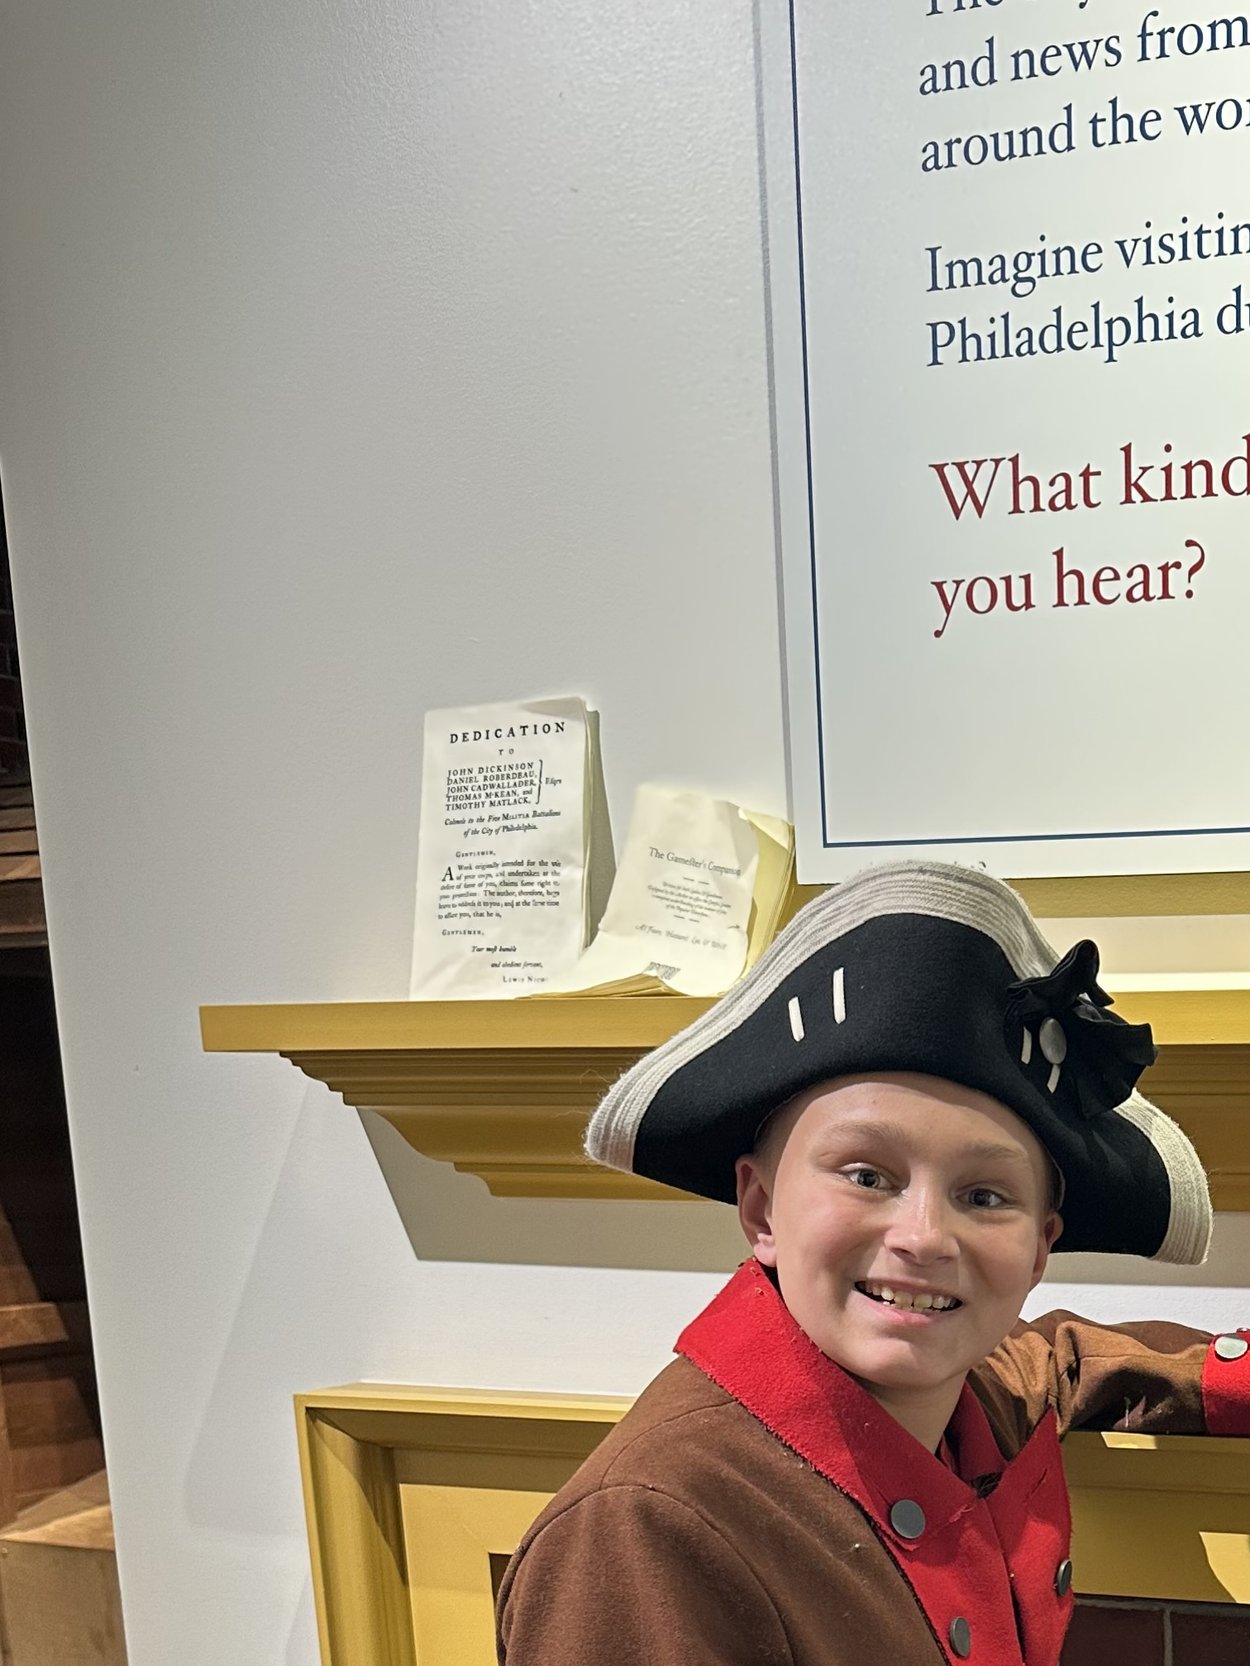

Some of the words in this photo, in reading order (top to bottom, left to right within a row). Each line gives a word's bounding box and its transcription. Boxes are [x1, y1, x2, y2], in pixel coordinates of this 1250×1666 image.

[918, 36, 998, 97] and
[1010, 35, 1123, 84] news
[921, 103, 1077, 173] around
[1088, 95, 1163, 149] the
[925, 234, 1104, 299] Imagine
[925, 295, 1204, 368] Philadelphia
[927, 453, 1102, 522] What
[930, 565, 1037, 639] you
[1051, 538, 1206, 609] hear?
[450, 722, 565, 744] DEDICATION
[448, 767, 474, 777] JOHN
[478, 762, 534, 775] DICKINSON
[447, 776, 479, 786] DANIEL
[446, 793, 482, 803] THOMAS
[447, 785, 473, 796] JOHN
[445, 801, 486, 811] TIMOTHY
[481, 826, 493, 836] City
[649, 846, 665, 860] The
[441, 866, 454, 882] A
